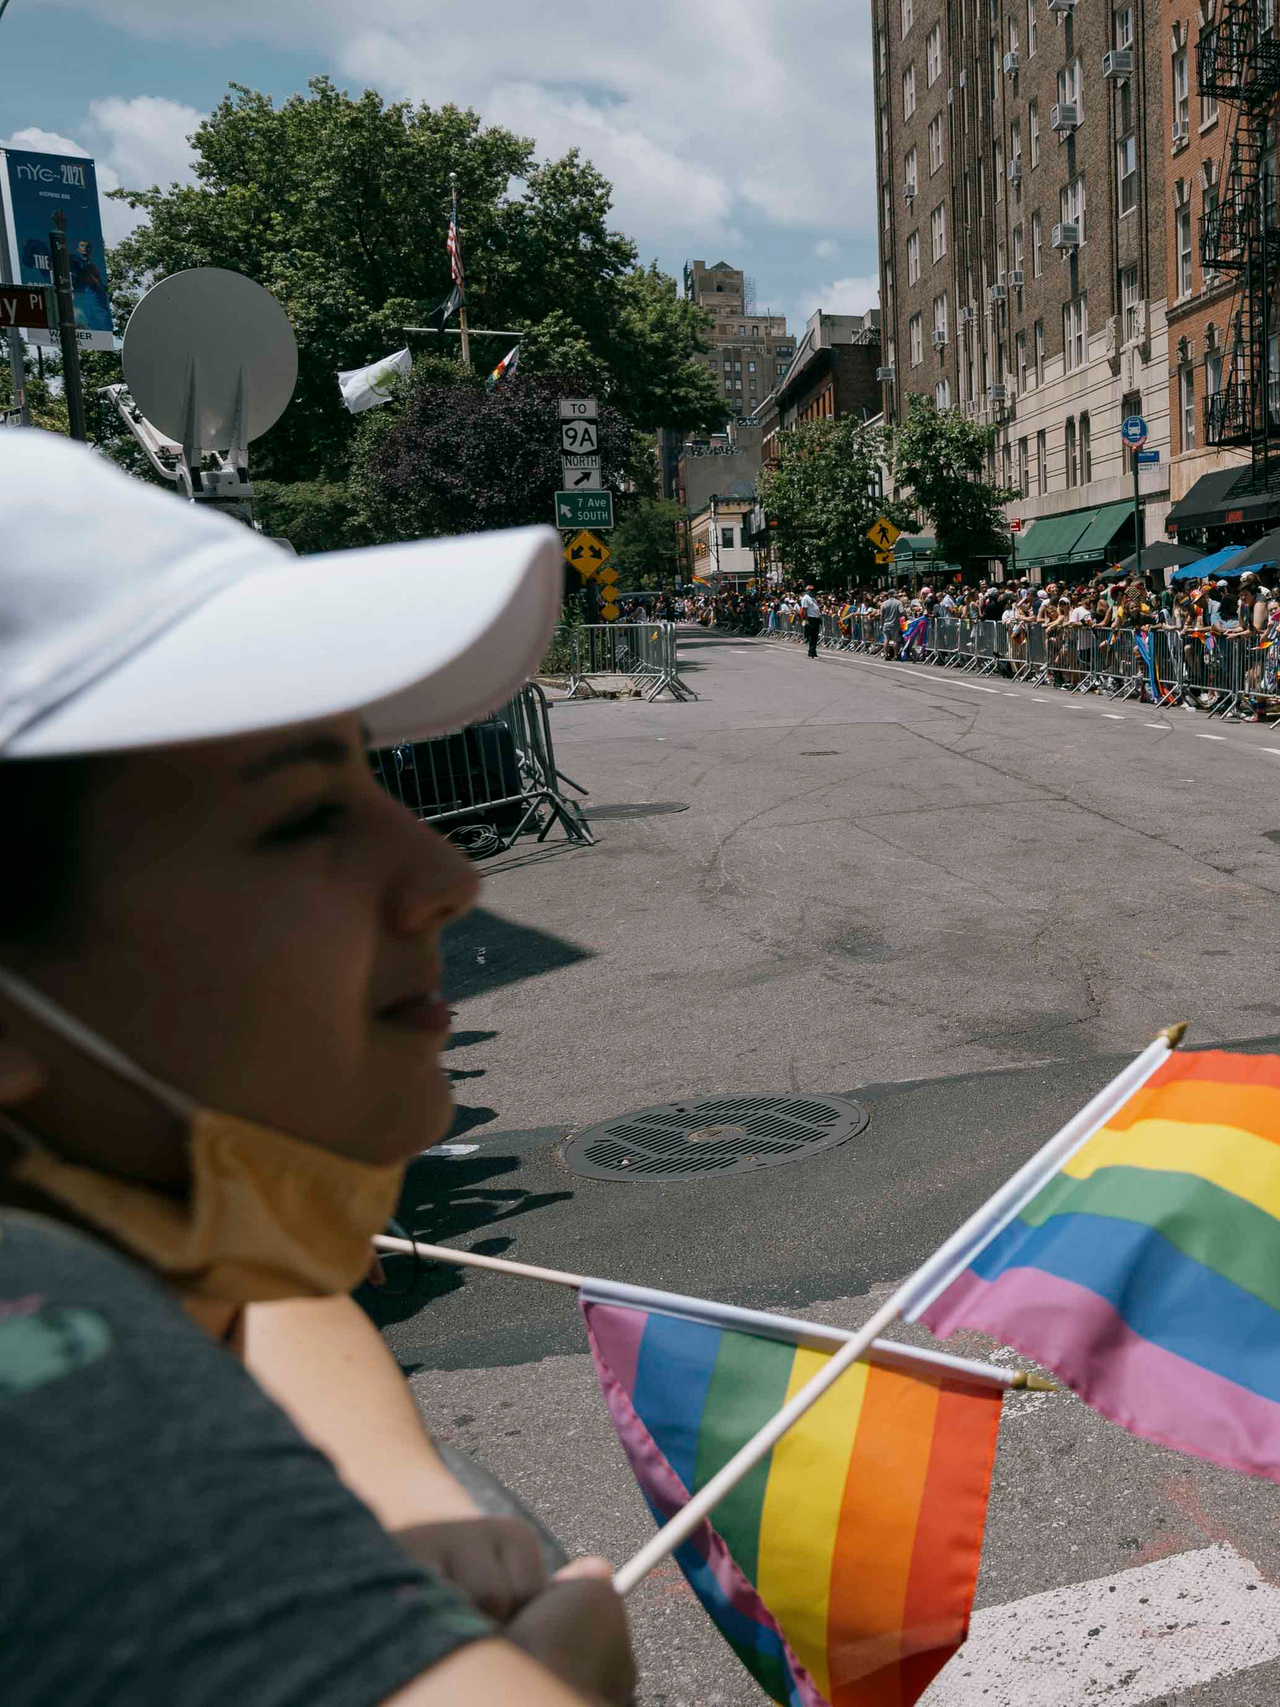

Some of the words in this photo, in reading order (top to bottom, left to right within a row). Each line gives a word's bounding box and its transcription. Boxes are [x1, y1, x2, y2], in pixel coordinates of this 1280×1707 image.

[61, 165, 85, 187] 2021
[33, 254, 50, 270] THE
[570, 403, 587, 414] TO
[564, 427, 595, 447] 9A
[565, 455, 598, 467] NORTH
[577, 498, 583, 507] 7
[587, 498, 607, 508] Ave
[577, 511, 608, 521] SOUTH
